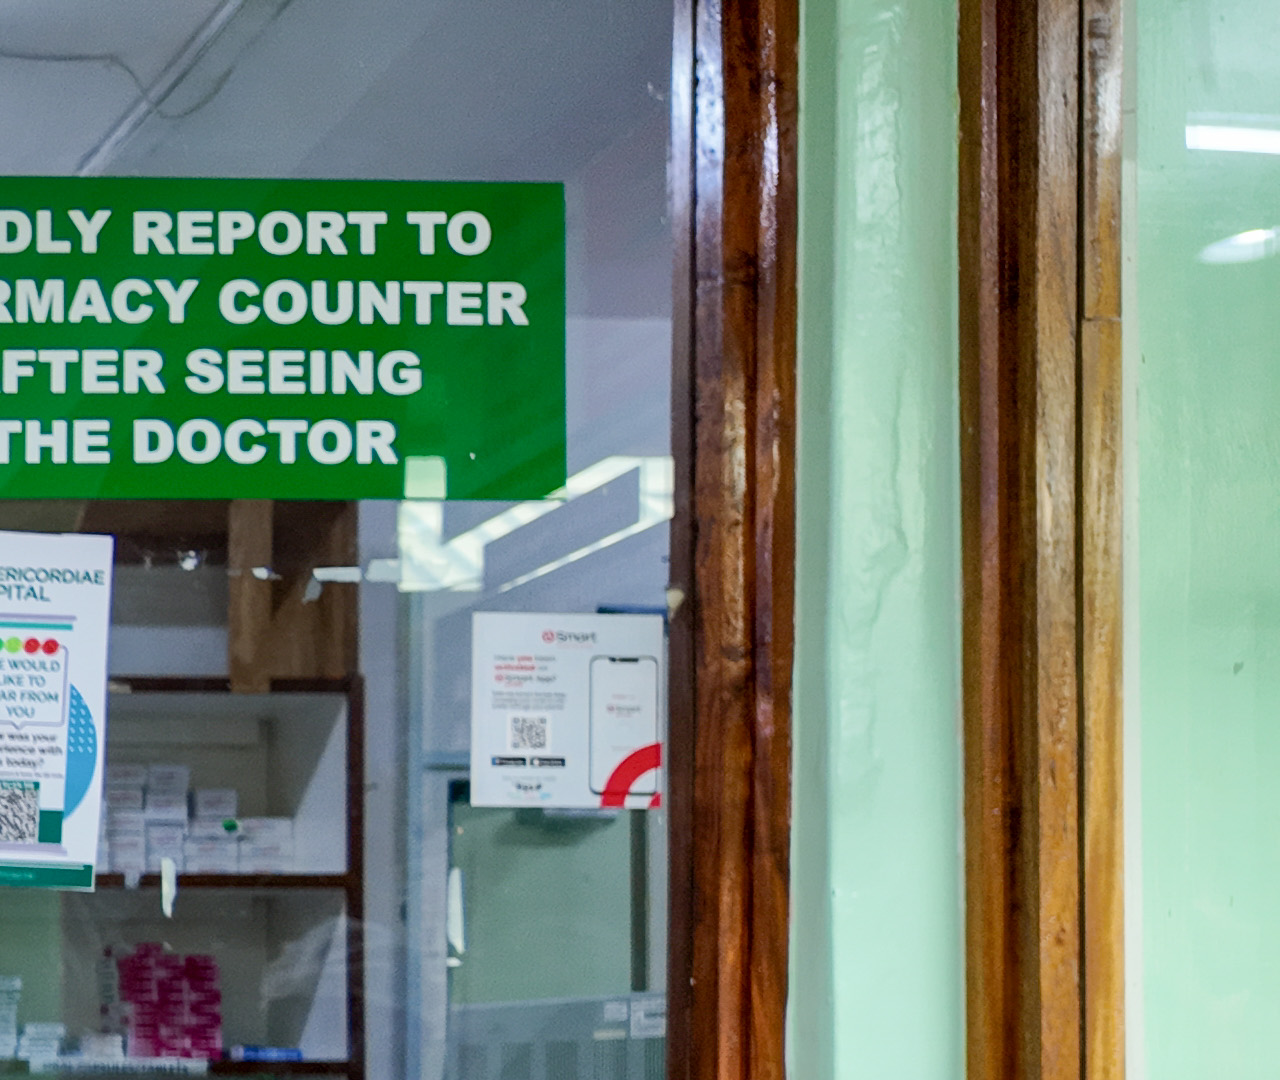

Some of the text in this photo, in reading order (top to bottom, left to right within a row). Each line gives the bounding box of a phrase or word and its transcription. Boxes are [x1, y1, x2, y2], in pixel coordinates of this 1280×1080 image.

[133, 210, 388, 255] REPORT
[406, 210, 492, 255] TO
[219, 279, 529, 326] COUNTER
[185, 348, 422, 395] SEEING
[133, 418, 399, 465] DOCTOR
[8, 658, 61, 673] WOULD
[28, 674, 46, 688] TO
[6, 705, 36, 718] YOU
[20, 690, 59, 703] FROM
